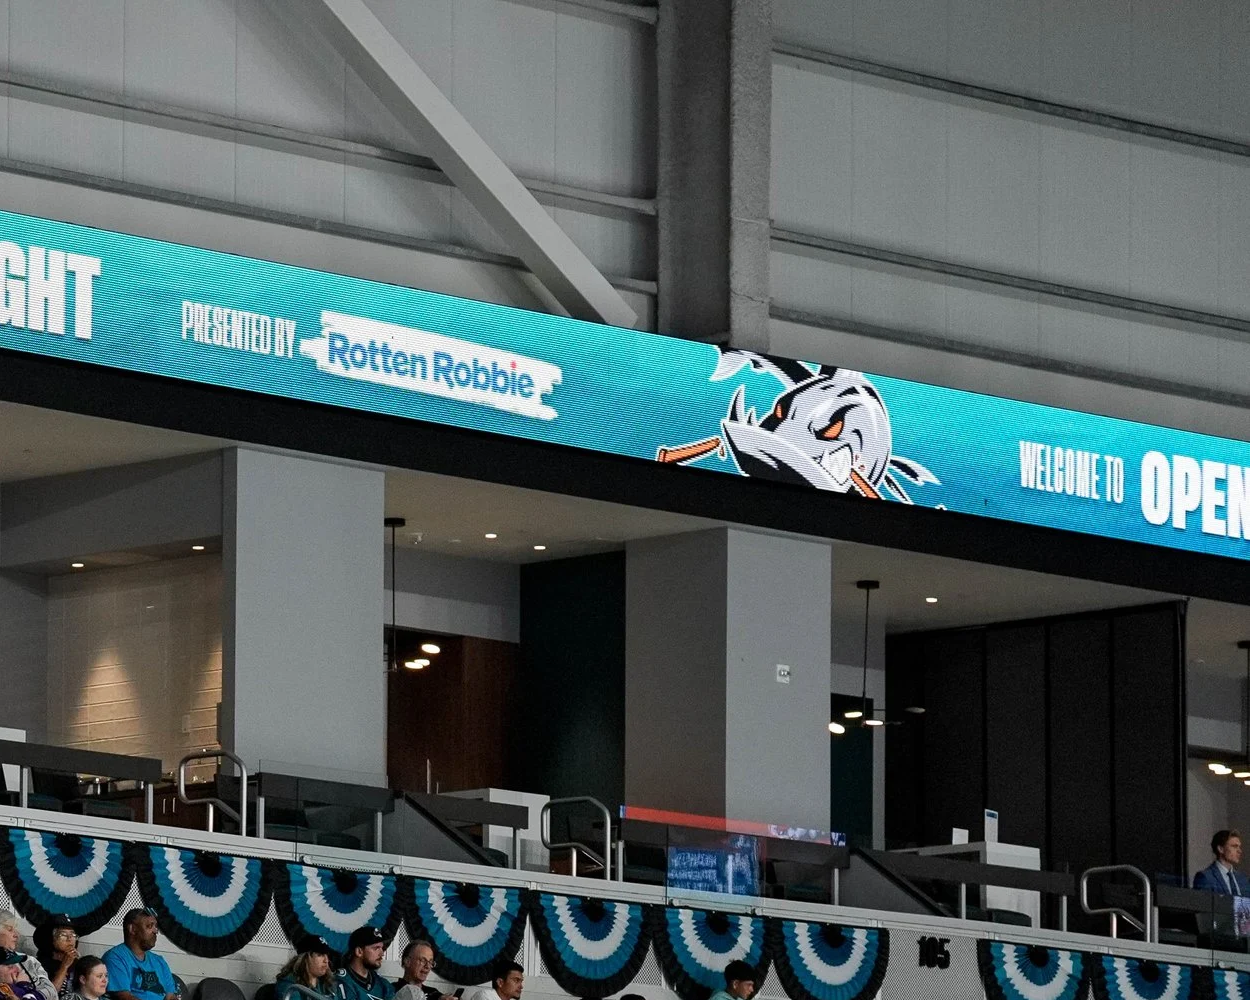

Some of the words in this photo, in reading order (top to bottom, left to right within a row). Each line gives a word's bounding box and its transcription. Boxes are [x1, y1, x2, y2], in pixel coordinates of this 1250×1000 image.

[181, 300, 271, 355] PRESENTED
[274, 318, 297, 359] BY
[327, 332, 428, 380] Rotten
[433, 351, 535, 398] Robbie
[1019, 440, 1101, 500] WELCOME
[1104, 455, 1124, 504] TO
[917, 935, 951, 970] 105
